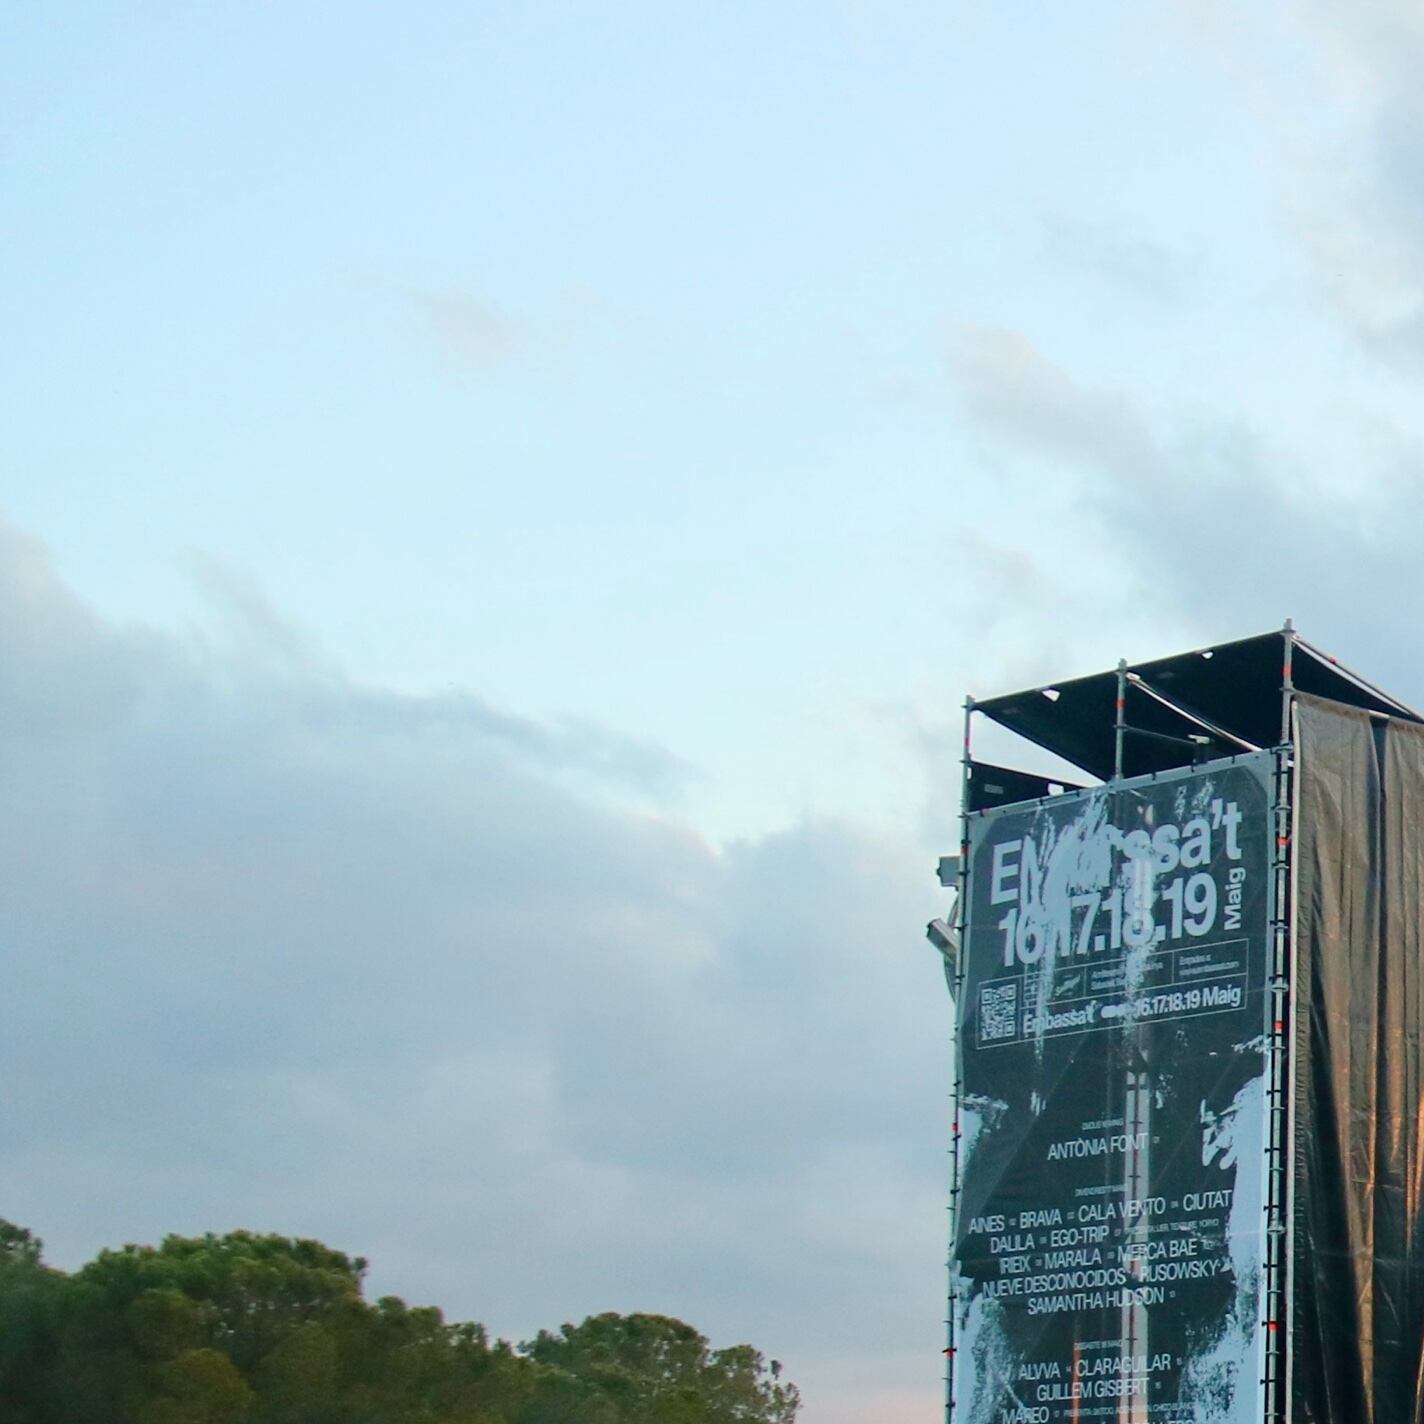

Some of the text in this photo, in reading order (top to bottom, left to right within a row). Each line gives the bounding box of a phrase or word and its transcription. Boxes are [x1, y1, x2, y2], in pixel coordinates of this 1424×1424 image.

[1223, 866, 1246, 931] Maig
[1202, 983, 1242, 1008] Maig
[1047, 1137, 1109, 1161] ANTÒNIA
[1110, 1131, 1149, 1153] FONT
[968, 1214, 1006, 1235] AINES
[1020, 1208, 1063, 1229] BRAVA
[1078, 1202, 1117, 1223] CALA
[1118, 1196, 1167, 1218] VENTO
[1182, 1189, 1233, 1212] CIUTAT
[990, 1233, 1036, 1254] DALILA
[1050, 1225, 1110, 1248] EGO-TRIP
[1044, 1247, 1103, 1270] MARALA
[1169, 1238, 1198, 1258] BAE
[982, 1259, 1219, 1299] NUEVE DESCONOCIDOS RUSOWSKY
[1028, 1286, 1165, 1316] SAMANTHA HUDSON
[1018, 1361, 1062, 1381] ALVVA
[1075, 1353, 1172, 1377] CLARAGUILAR
[1036, 1381, 1093, 1402] GUILLEM
[1094, 1376, 1151, 1398] GISBERT
[1001, 1406, 1050, 1424] MAREO
